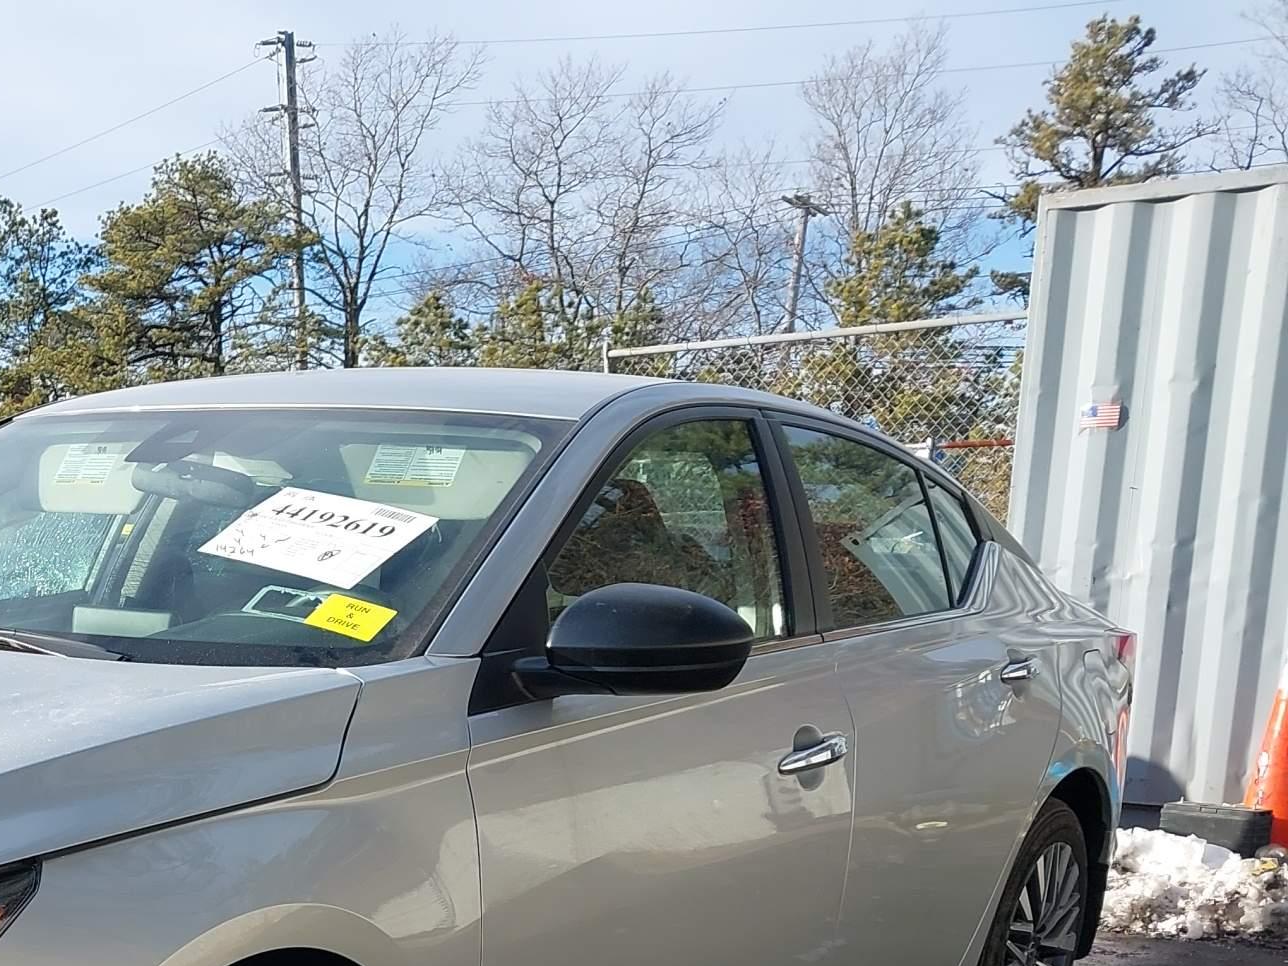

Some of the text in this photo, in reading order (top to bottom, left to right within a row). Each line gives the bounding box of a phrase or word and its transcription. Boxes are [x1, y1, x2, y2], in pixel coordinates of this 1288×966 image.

[272, 503, 396, 538] 44192619
[346, 602, 371, 614] RUN
[326, 616, 361, 631] DRIVE
